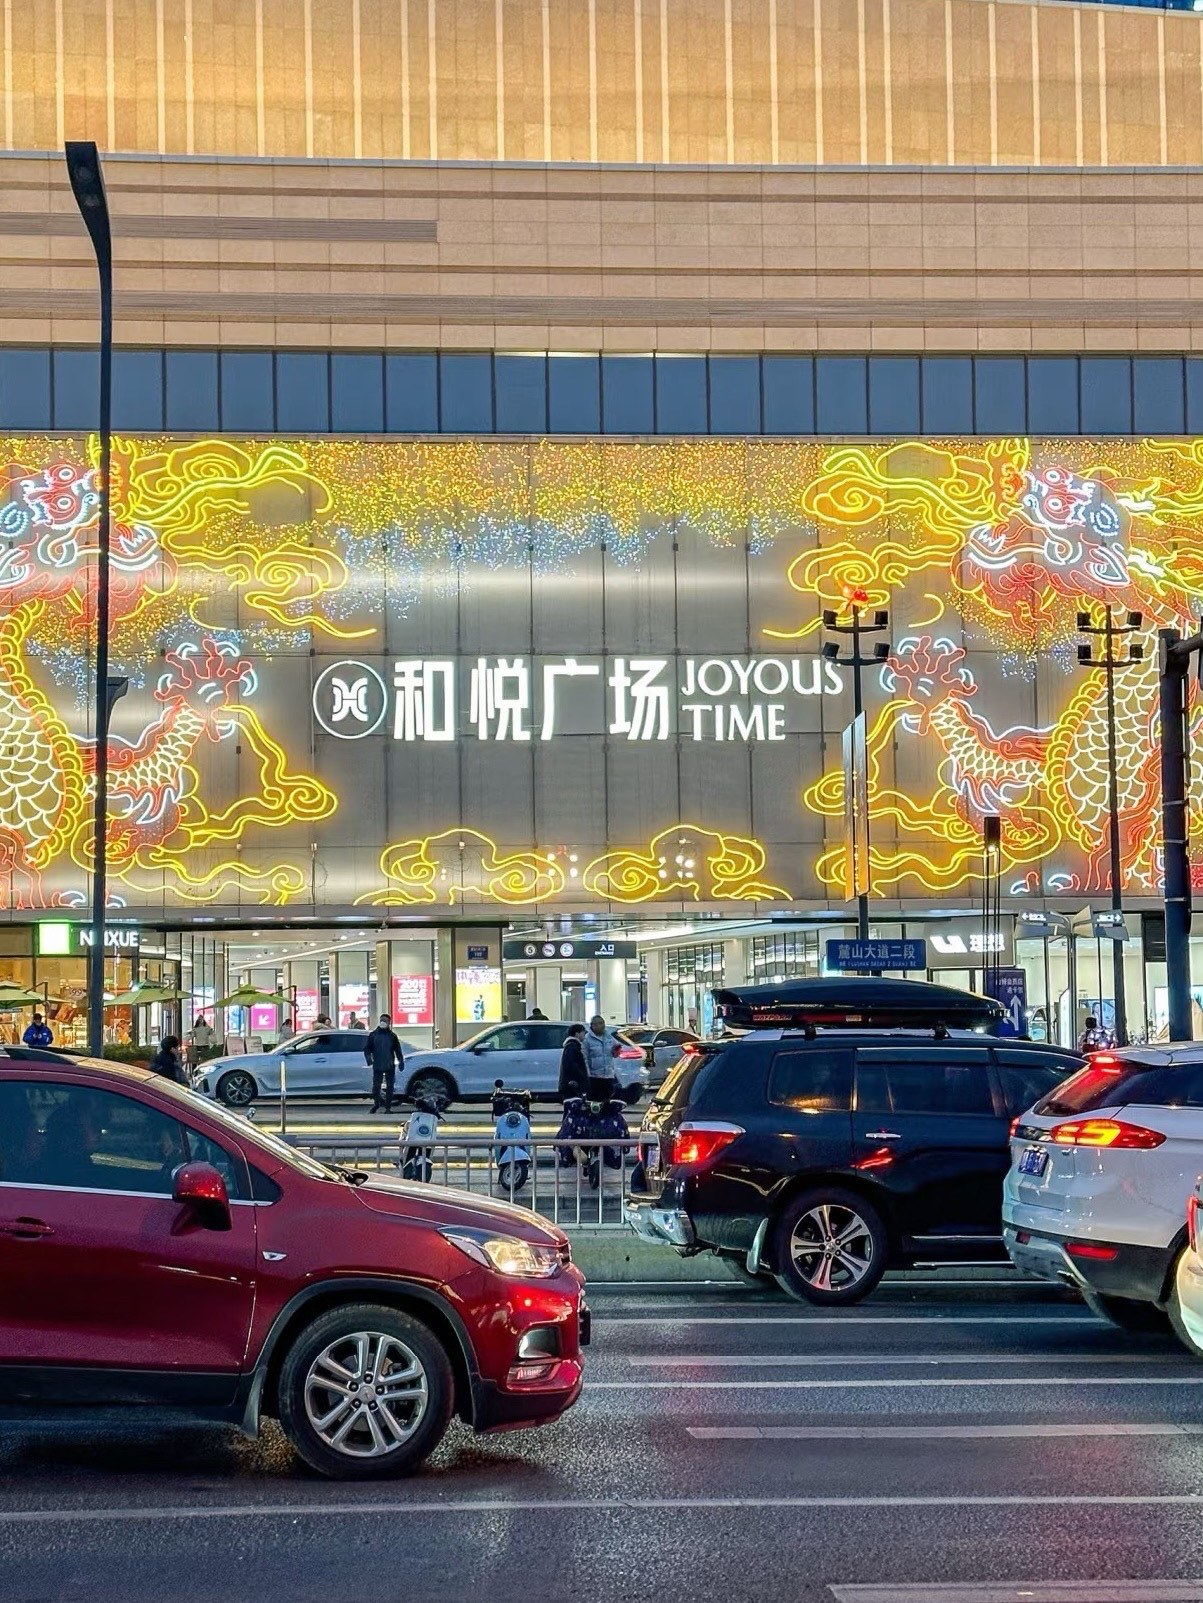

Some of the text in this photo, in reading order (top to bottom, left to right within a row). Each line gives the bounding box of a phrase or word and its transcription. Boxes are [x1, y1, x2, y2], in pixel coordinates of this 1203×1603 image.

[681, 658, 845, 696] JOYOUS
[393, 657, 669, 741] 和悦广场
[681, 704, 787, 741] TIME
[80, 930, 139, 946] NIXUE
[600, 944, 615, 952] 入口
[838, 943, 916, 959] 麓山大道二段
